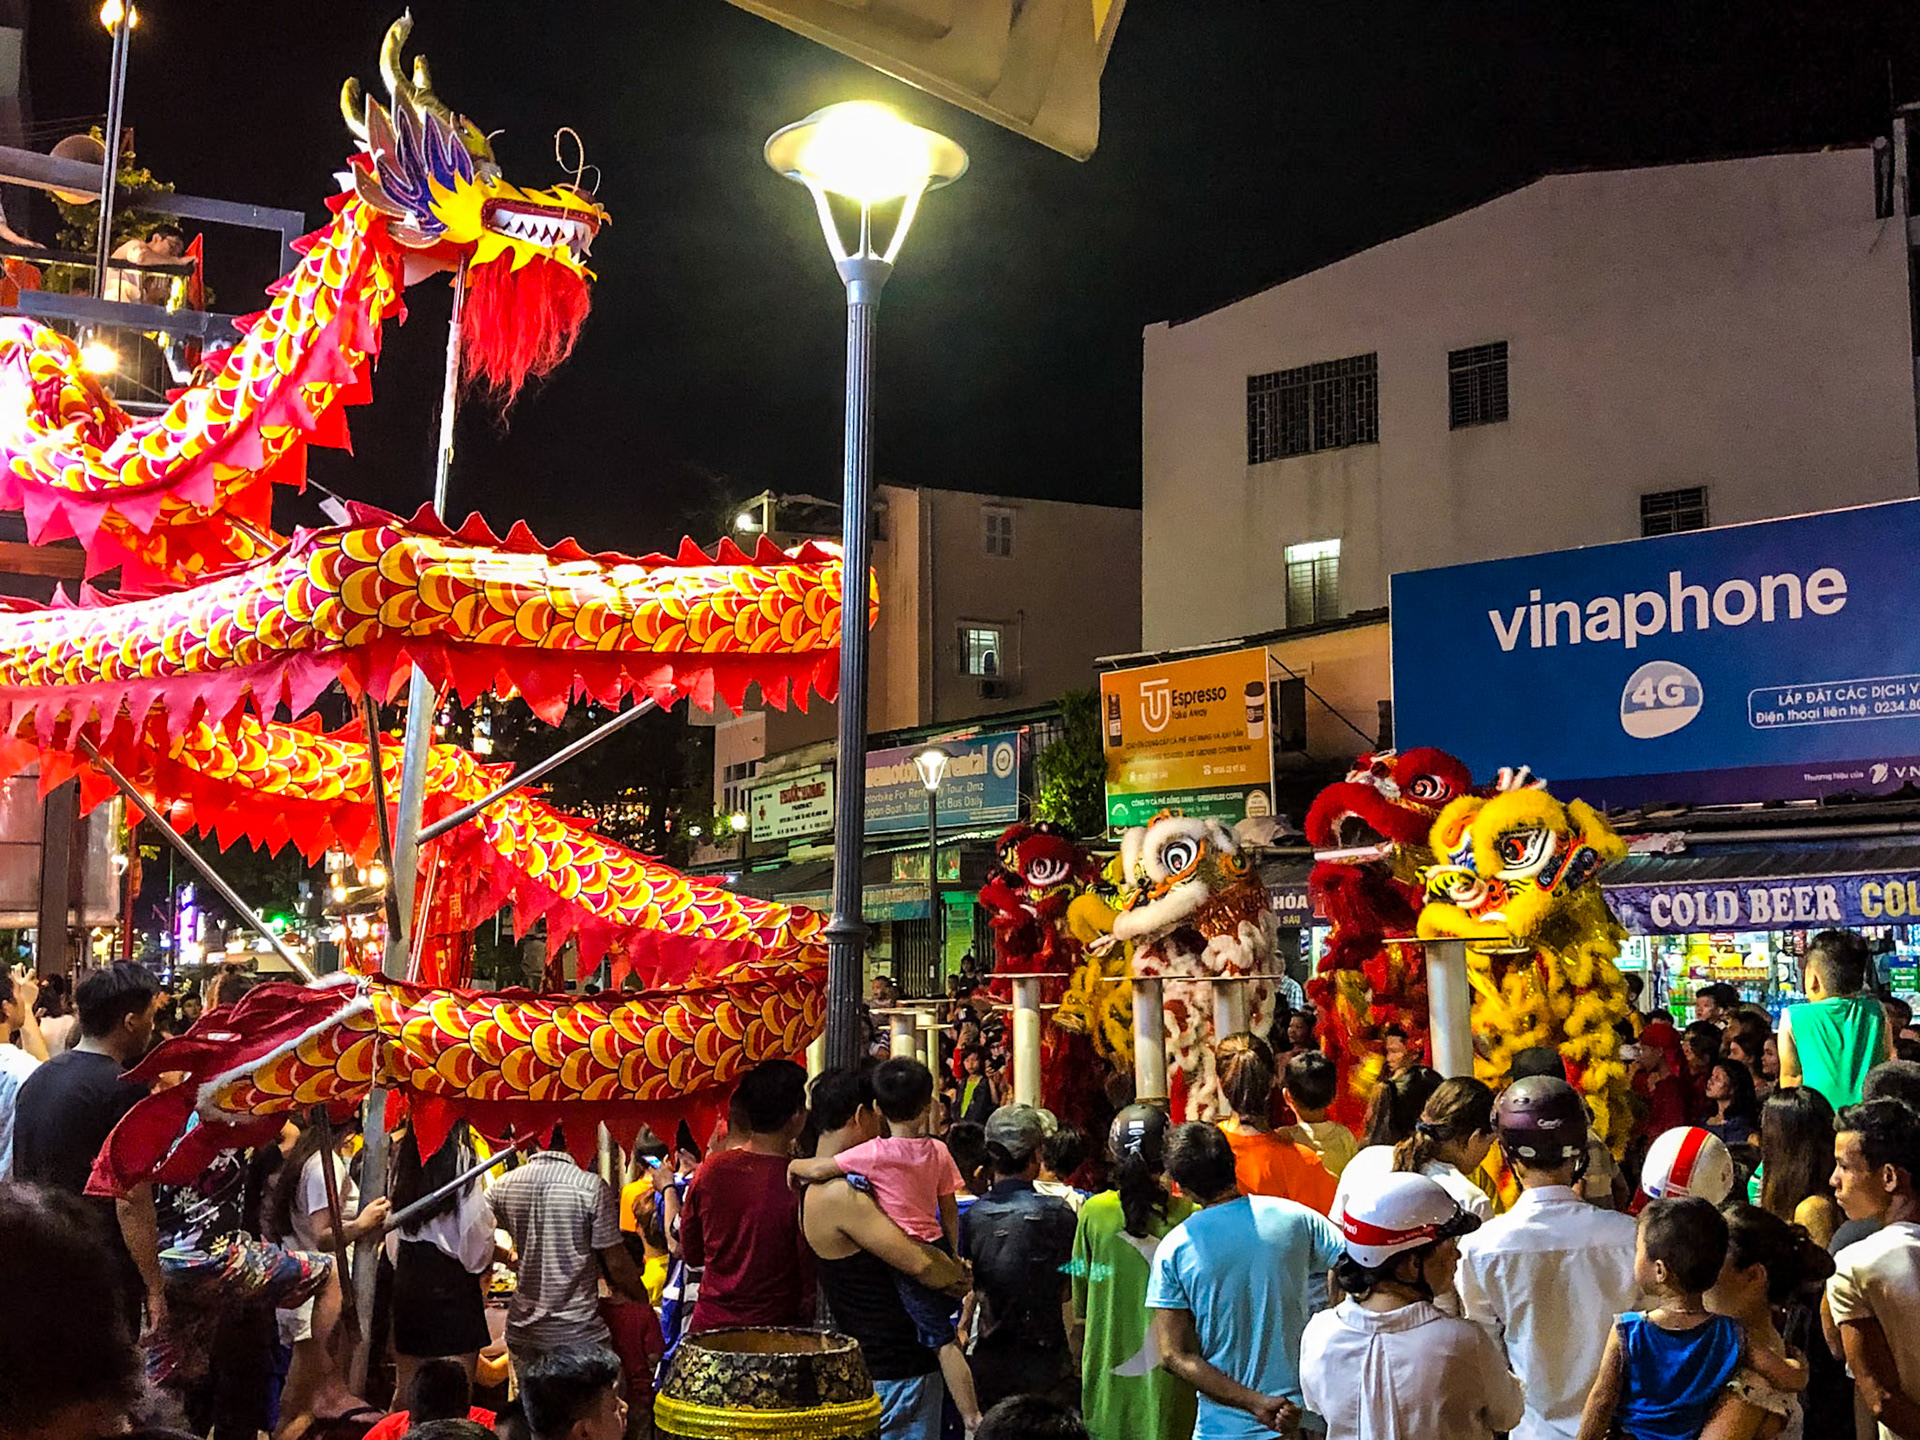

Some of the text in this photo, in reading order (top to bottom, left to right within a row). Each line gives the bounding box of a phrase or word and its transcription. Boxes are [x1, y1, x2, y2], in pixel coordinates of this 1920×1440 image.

[1488, 567, 1848, 652] vinaphone
[1172, 686, 1227, 708] Espresso
[1631, 675, 1686, 708] 4G
[1835, 685, 1867, 700] CÁC
[1872, 683, 1906, 700] DỊCH
[1756, 711, 1784, 724] Điện
[1787, 708, 1820, 722] thoại
[1823, 707, 1847, 718] liên
[865, 791, 894, 804] otorbike
[895, 789, 907, 799] For
[967, 780, 984, 792] Dmz
[947, 797, 962, 808] Bus
[964, 796, 983, 809] Daily
[1650, 884, 1842, 928] COLD BEER
